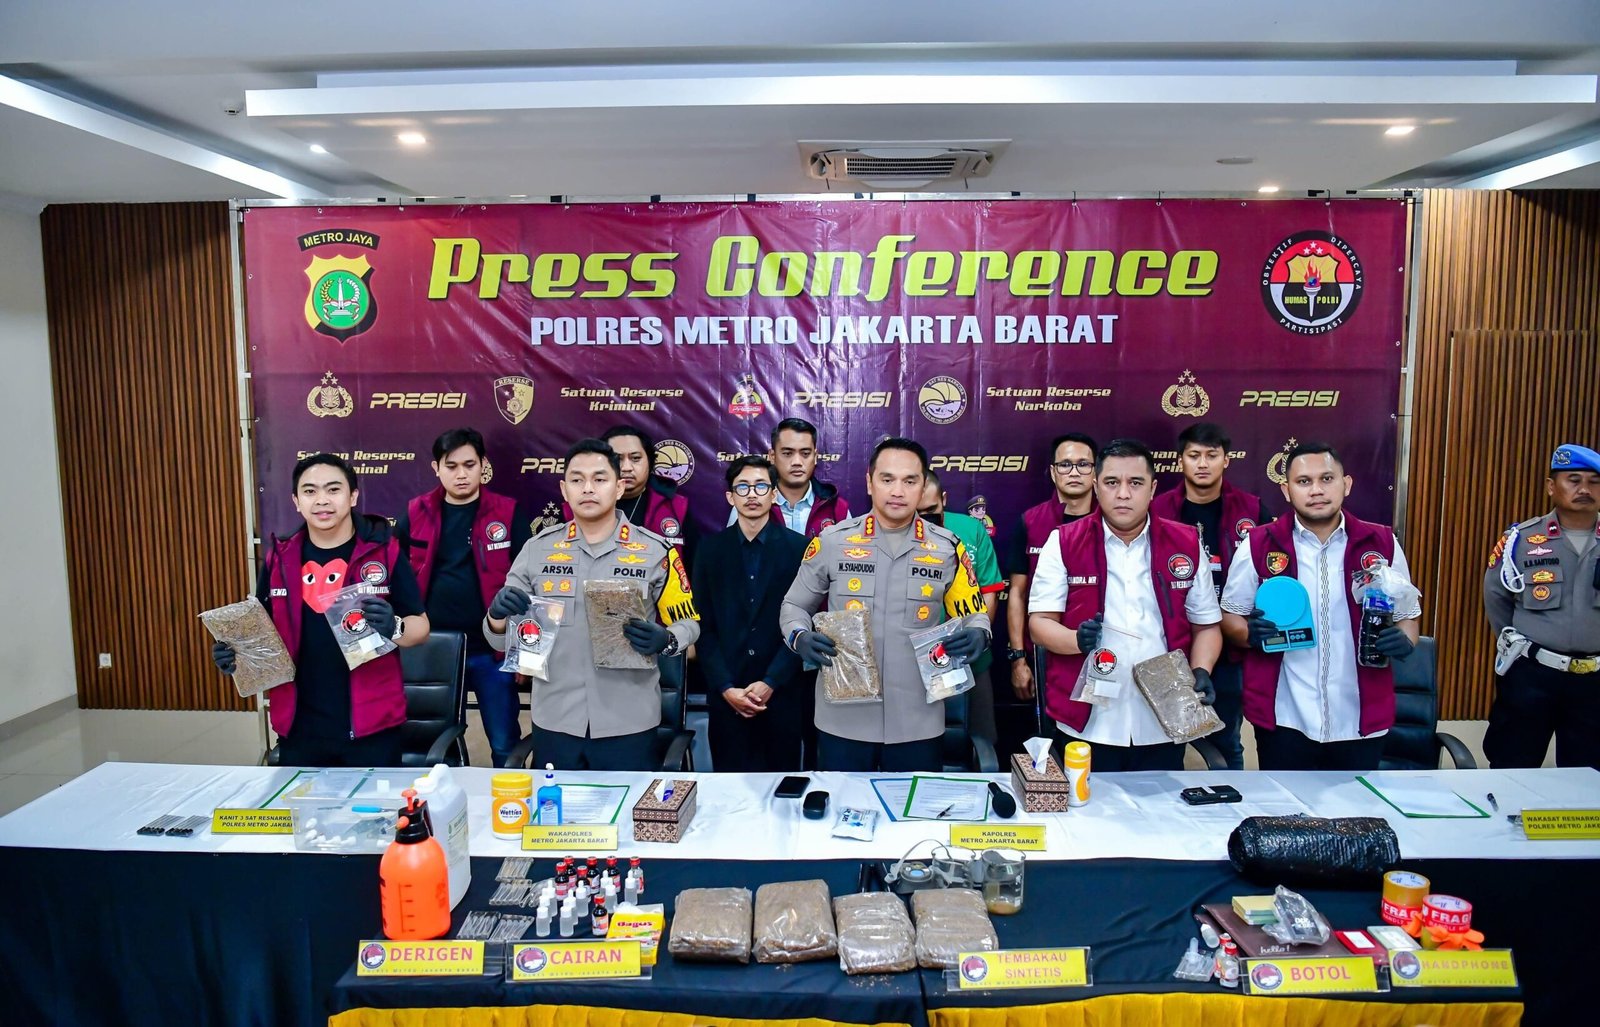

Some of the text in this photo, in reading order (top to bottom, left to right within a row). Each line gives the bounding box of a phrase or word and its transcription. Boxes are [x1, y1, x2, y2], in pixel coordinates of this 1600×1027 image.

[303, 232, 373, 247] METRO JAYA
[428, 234, 1219, 302] Press Conference
[1262, 238, 1293, 286] OBYEKTIF
[1331, 236, 1362, 290] DIPERCAYA
[1284, 296, 1339, 304] HUMAS POLRI
[531, 314, 1118, 346] POLRES METRO JAKARTA BARAT
[1280, 318, 1343, 334] PARTISIPASI
[498, 377, 530, 386] RESERSE
[560, 387, 684, 398] Satuan Reserse
[986, 386, 1111, 398] Satuan Reserse
[1239, 390, 1340, 407] PRESISI
[369, 392, 467, 409] PRESISI
[588, 400, 656, 412] Kriminal
[793, 391, 892, 408] PRESISI
[1014, 400, 1082, 412] Narkoba
[353, 450, 416, 461] Reserse
[929, 455, 1029, 473] PRESISI
[542, 565, 574, 575] ARSYA
[613, 567, 646, 579] POLRI
[911, 567, 942, 580] POLRI
[954, 598, 970, 618] KA
[499, 808, 522, 816] Wetties
[390, 947, 473, 962] DERIGEN
[1260, 944, 1291, 954] hello!
[549, 949, 622, 965] CAIRAN
[997, 951, 1068, 964] TEMBAKAU
[1422, 960, 1509, 970] HANDPHONE
[1005, 967, 1062, 979] SINTETIS
[1291, 966, 1351, 981] BOTOL
